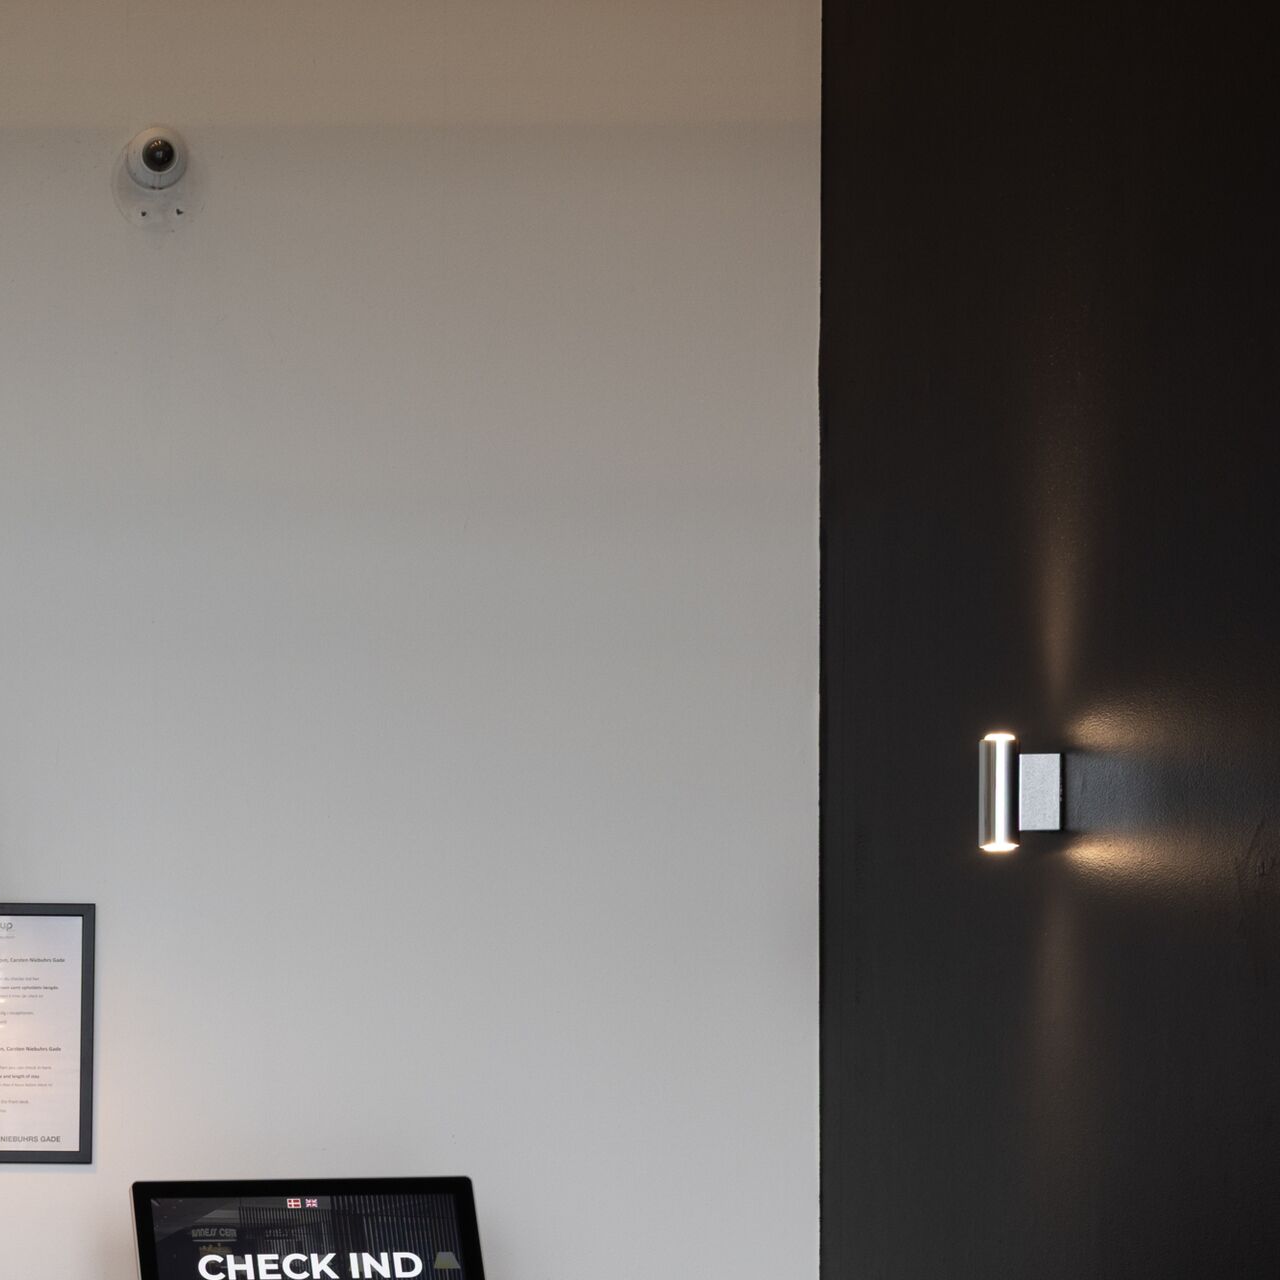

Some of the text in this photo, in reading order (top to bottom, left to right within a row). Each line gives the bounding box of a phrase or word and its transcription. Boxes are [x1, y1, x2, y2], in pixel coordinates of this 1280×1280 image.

[0, 1135, 39, 1143] NIEBUHRS
[40, 1135, 61, 1143] GADE
[349, 1252, 423, 1279] IND
